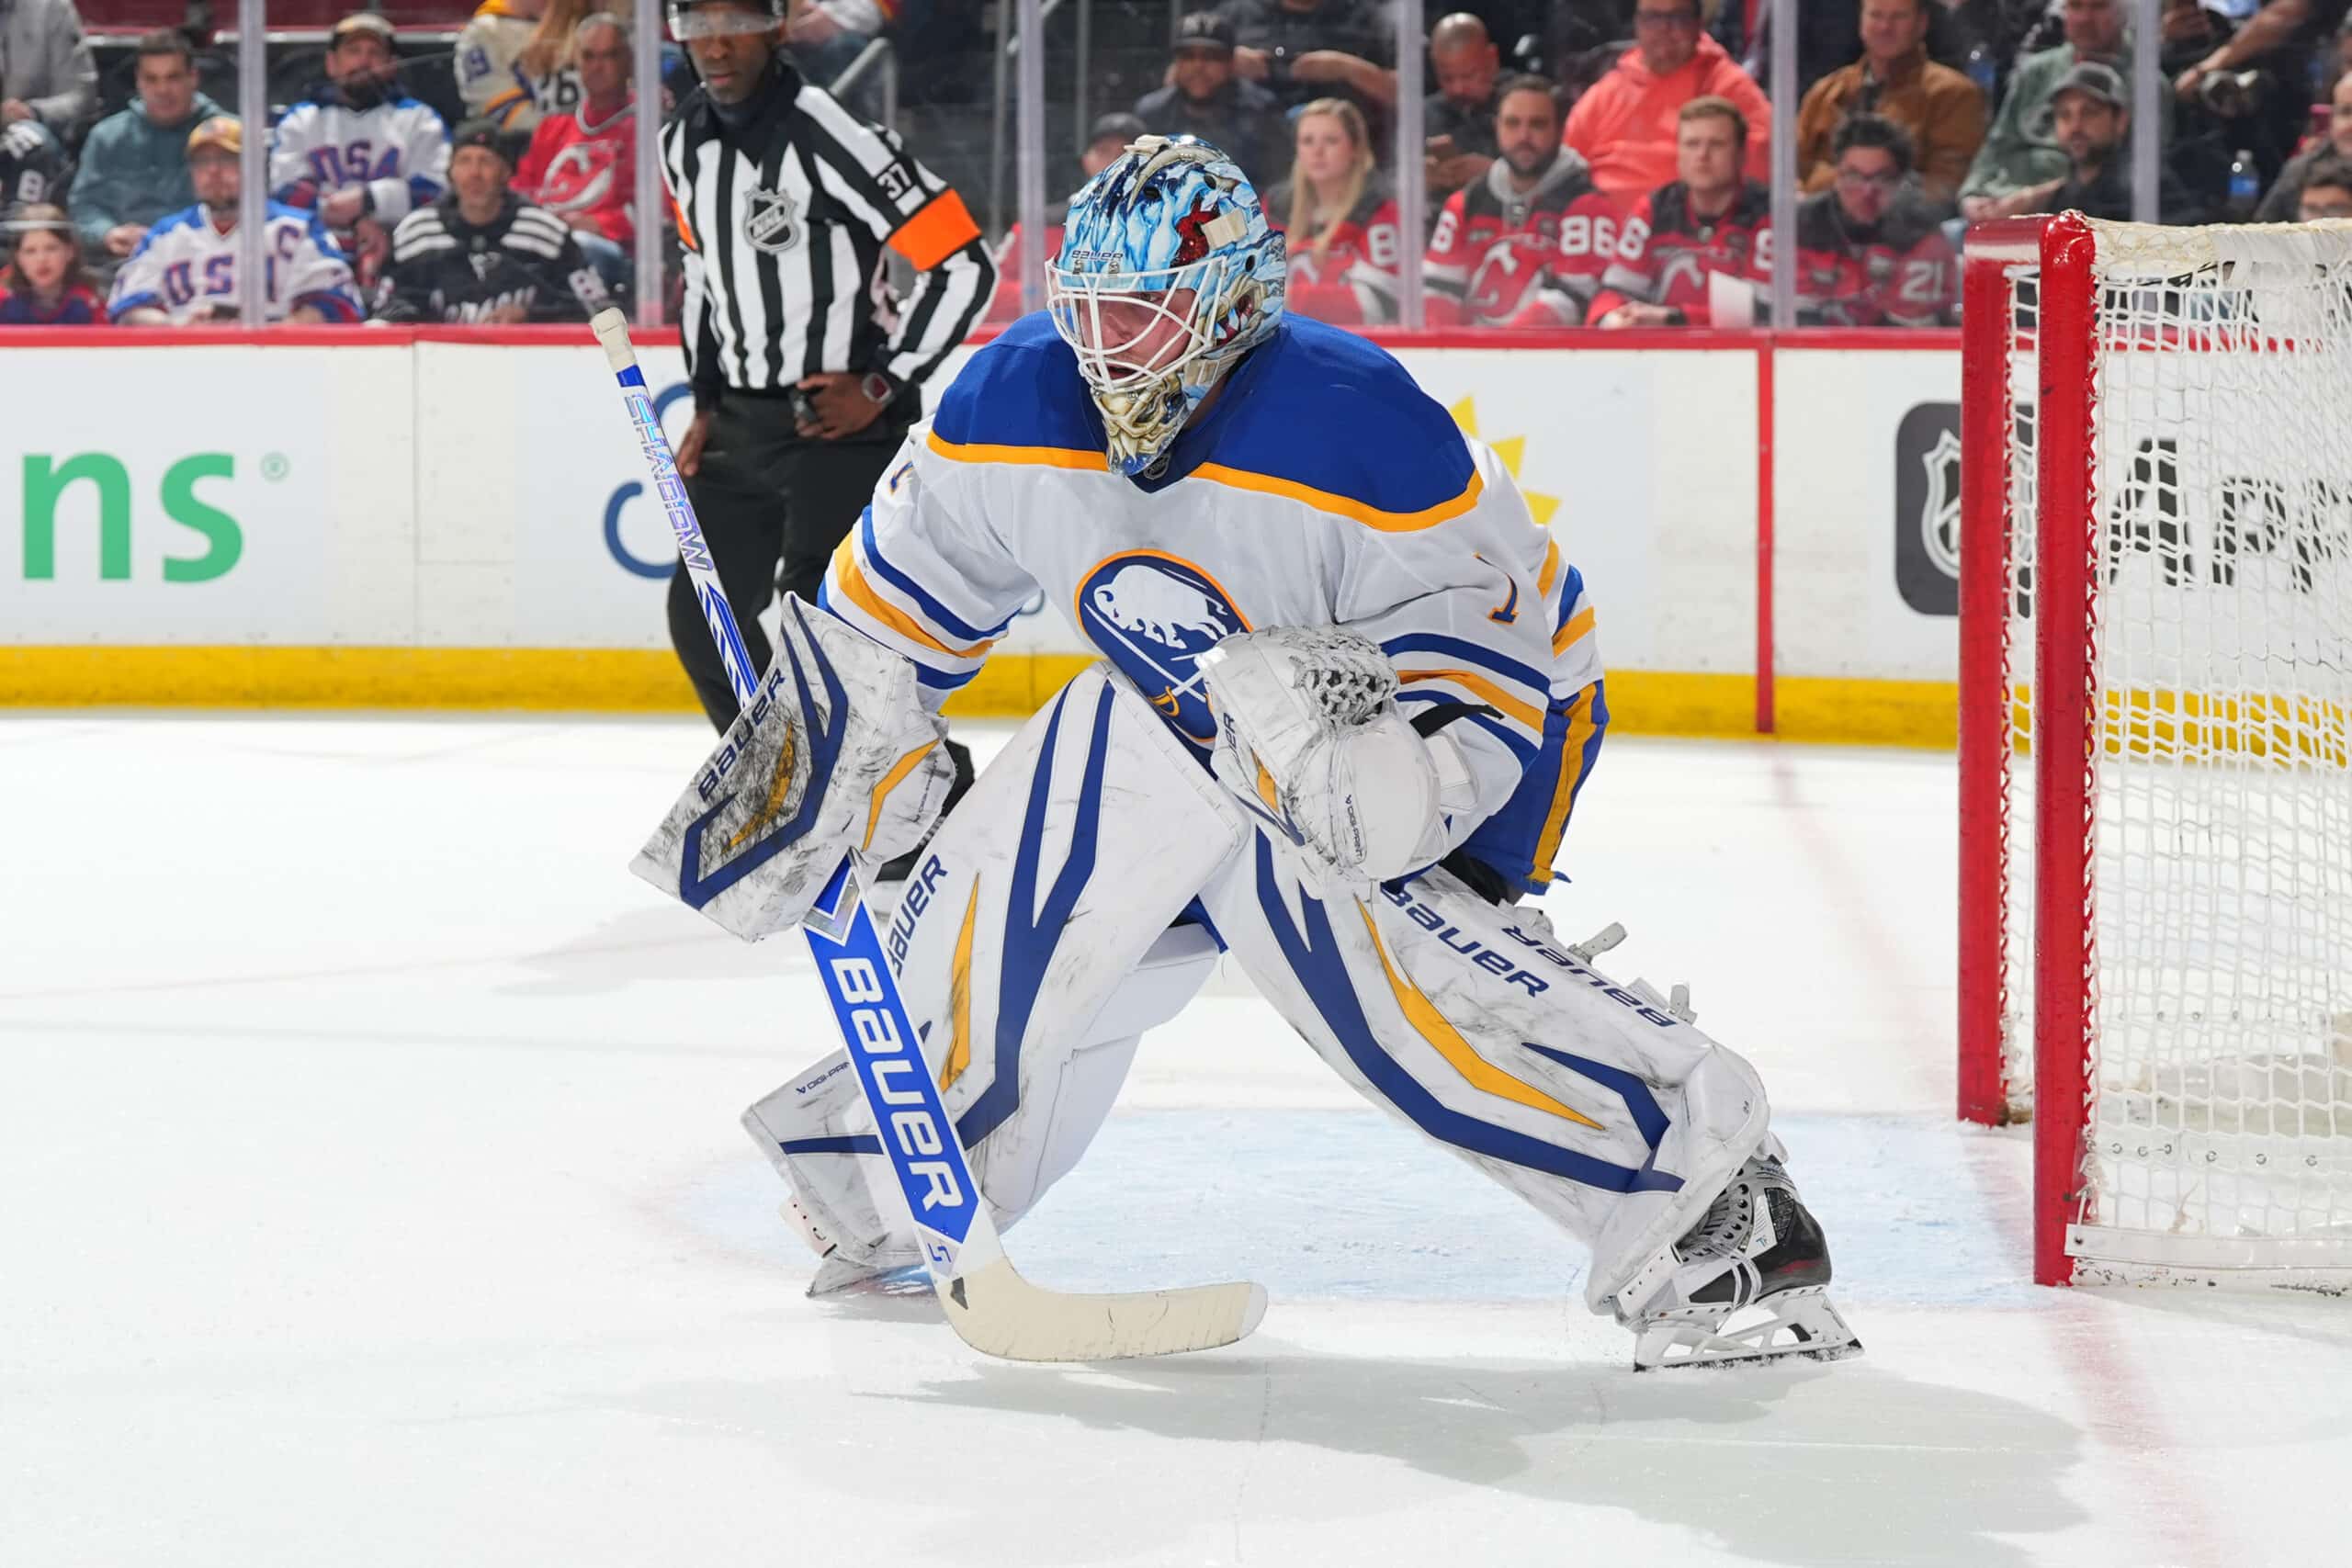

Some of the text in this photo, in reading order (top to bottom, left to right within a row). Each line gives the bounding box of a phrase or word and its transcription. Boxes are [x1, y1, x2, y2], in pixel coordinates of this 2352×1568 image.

[876, 163, 912, 200] 37
[697, 667, 786, 803] BAUER
[830, 957, 964, 1213] BAUER
